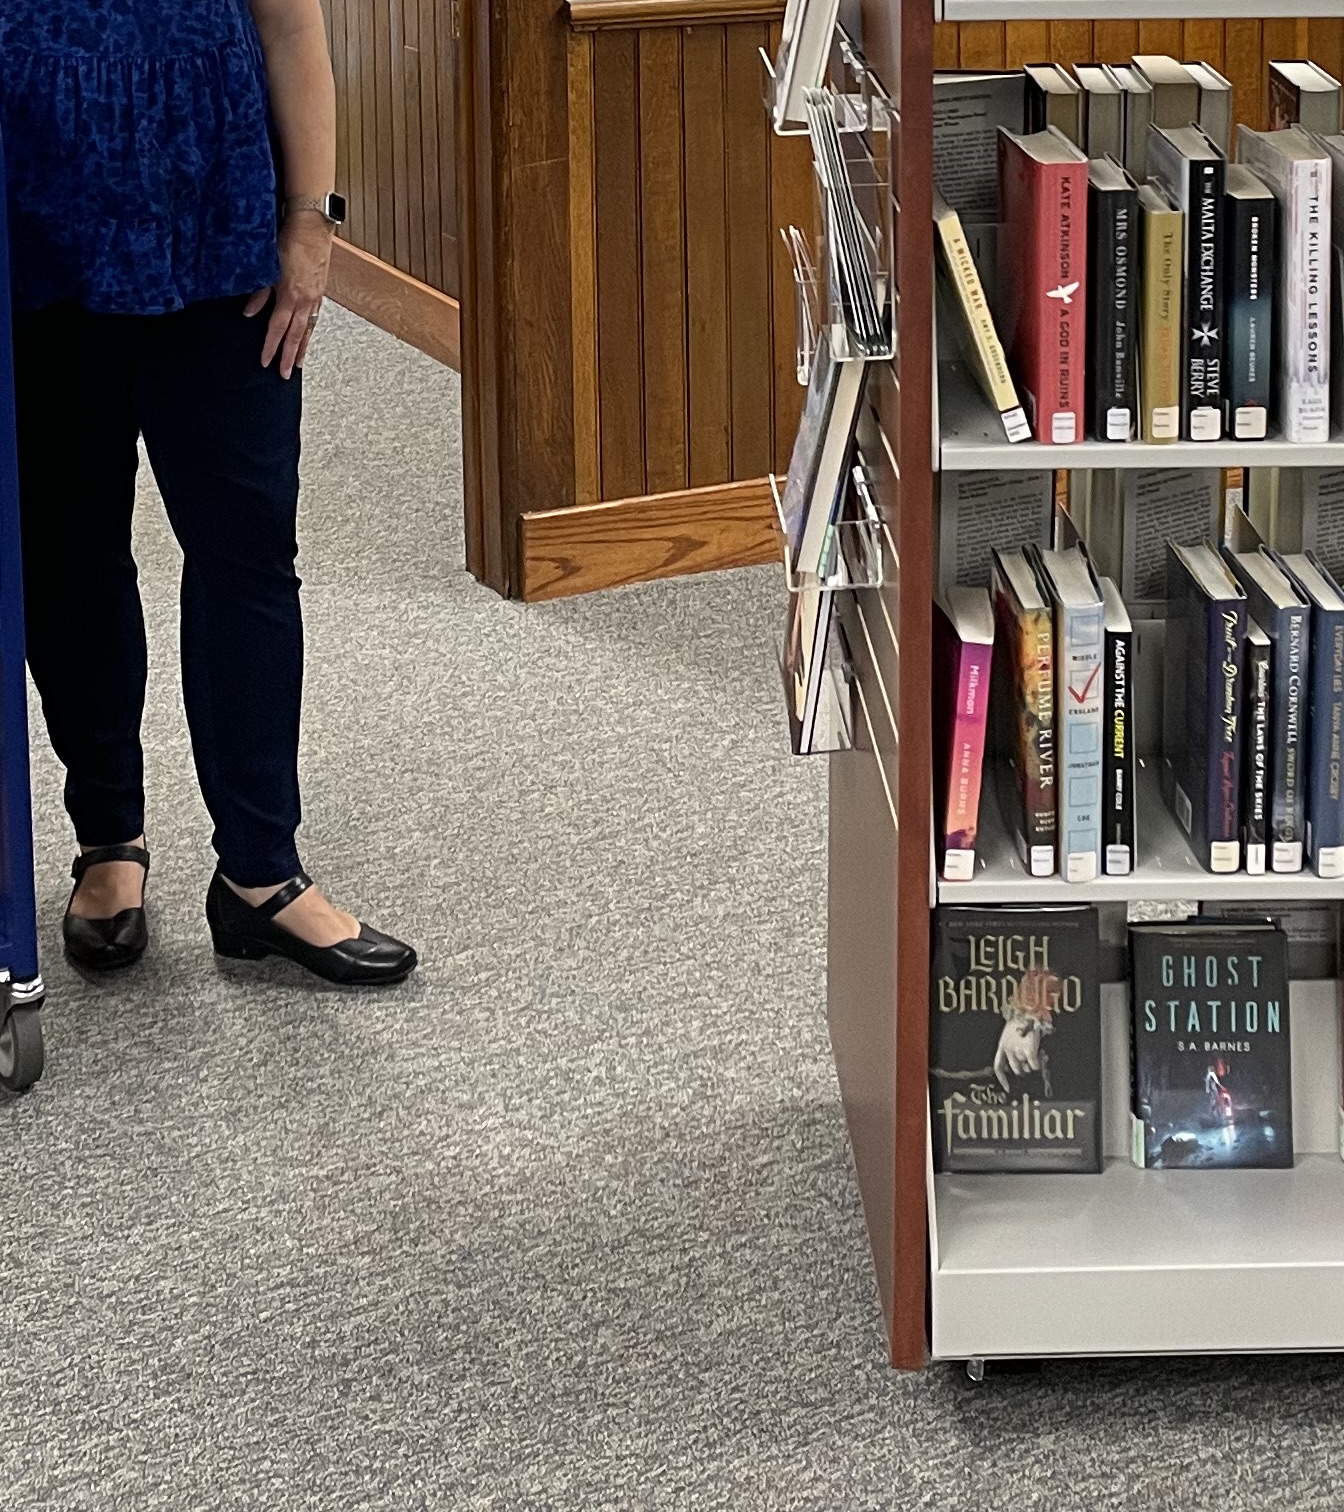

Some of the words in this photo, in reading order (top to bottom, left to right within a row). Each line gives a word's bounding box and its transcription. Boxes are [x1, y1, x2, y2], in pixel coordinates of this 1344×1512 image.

[1200, 197, 1215, 240] MALTA
[1307, 194, 1319, 225] THE
[1115, 245, 1129, 310] OSMOND
[1199, 242, 1214, 311] EXCHANGE
[1306, 231, 1318, 295] KILLING
[1306, 302, 1318, 375] LESSONS
[1191, 358, 1205, 399] BERRY
[1206, 358, 1220, 397] STEVE
[1114, 639, 1126, 685] AGAINST
[1289, 614, 1303, 673] BERNARD
[1036, 632, 1052, 722] PERFUME
[1038, 729, 1054, 789] RIVER
[968, 935, 1050, 972] LEIGH
[1162, 955, 1262, 988] GHOST
[938, 975, 1082, 1014] BARDUGO
[1144, 1000, 1281, 1034] STATION
[938, 1093, 1086, 1157] familiar
